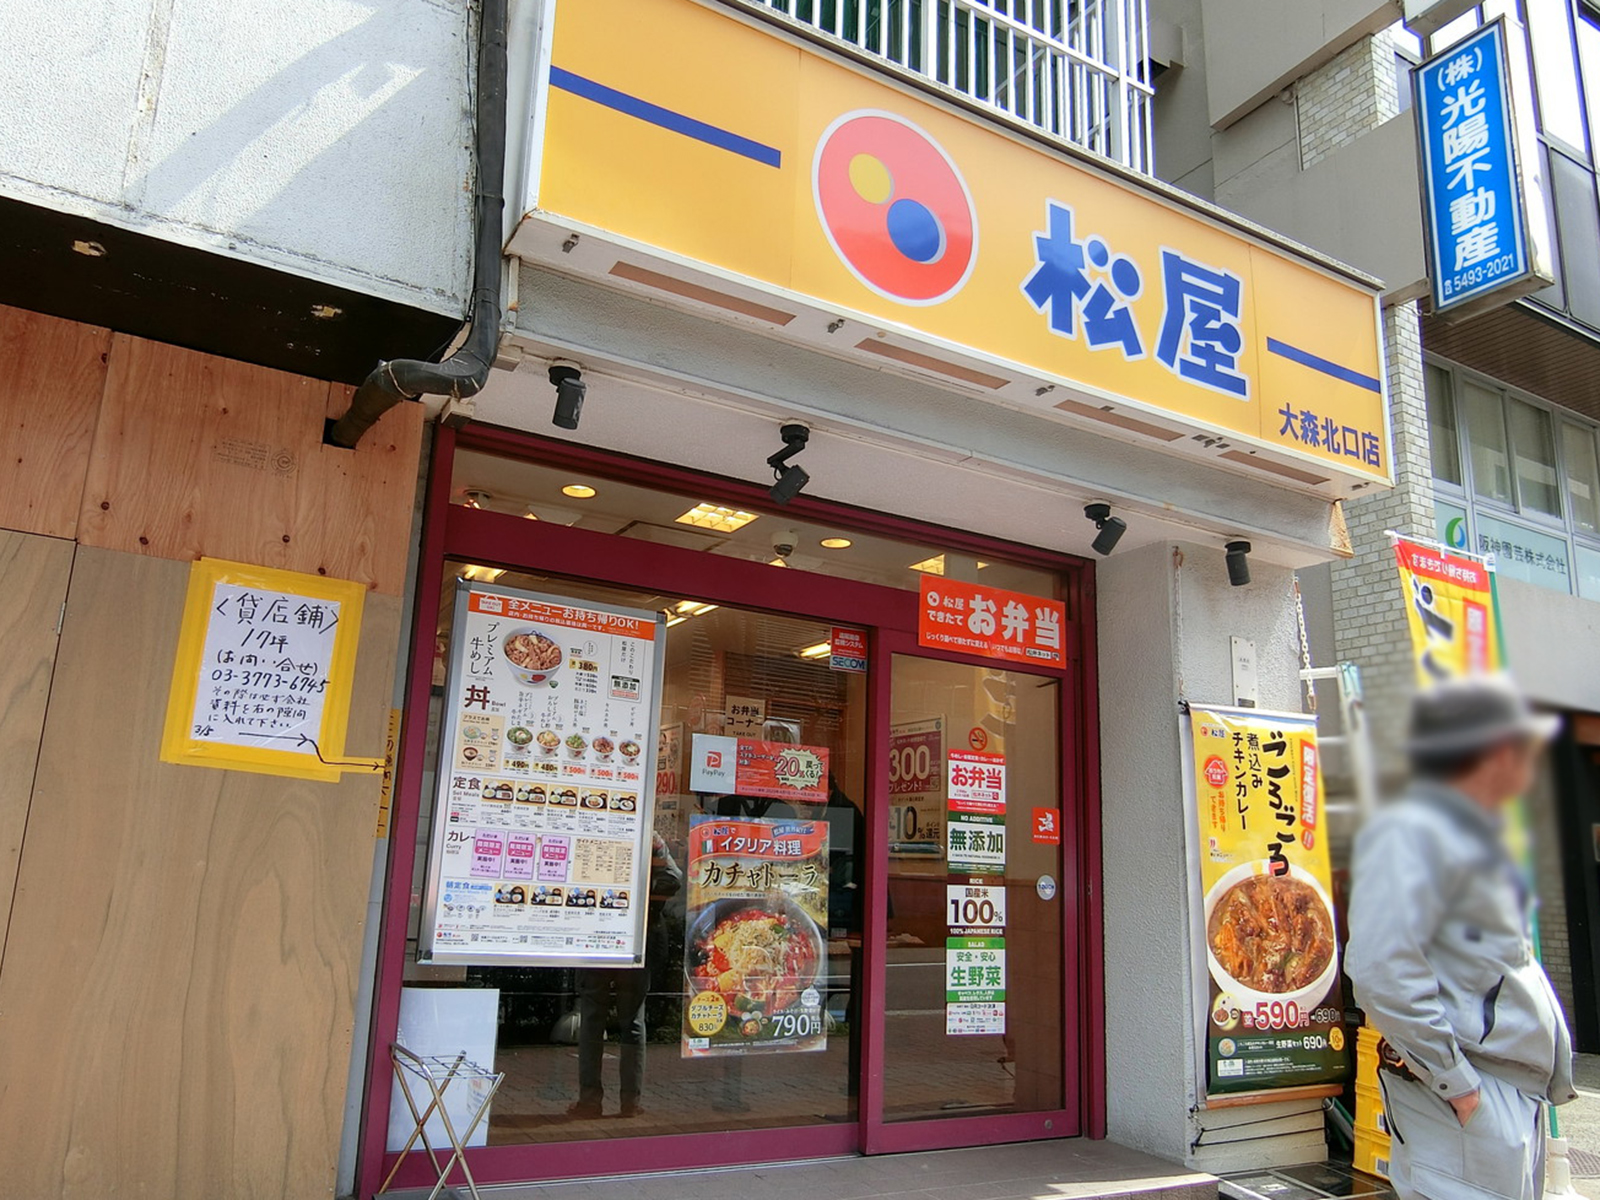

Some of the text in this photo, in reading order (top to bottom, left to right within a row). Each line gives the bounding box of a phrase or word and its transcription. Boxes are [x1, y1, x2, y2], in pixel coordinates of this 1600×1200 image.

[1453, 253, 1515, 292] 5493-2021
[1021, 199, 1249, 399] 松屋
[1278, 403, 1381, 468] 大森北口店
[508, 599, 640, 630] 全メニューお持ち帰りOK!
[943, 595, 964, 611] 松屋
[927, 609, 964, 626] できたて
[967, 593, 1060, 650] お弁当
[241, 628, 289, 653] 17坪
[483, 621, 500, 676] プレミアム
[470, 637, 482, 675] 牛めし
[832, 656, 865, 670] SECOM
[211, 669, 330, 693] 03-3773-6745
[464, 684, 491, 710] 丼
[726, 717, 763, 727] コーナー
[731, 704, 760, 717] お弁当
[1211, 728, 1226, 738] 松屋
[702, 768, 726, 778] PayPay
[805, 760, 823, 770] 戻って
[1246, 732, 1263, 789] 煮込み
[452, 776, 481, 790] 定食
[951, 764, 1002, 790] お弁当
[1232, 732, 1249, 830] チキンカレー
[1262, 730, 1296, 877] ごろごろ
[720, 836, 802, 856] イタリア料理
[950, 828, 1003, 853] 無添加
[701, 860, 818, 889] カチャトーラ
[965, 888, 989, 898] 国産米
[950, 899, 1003, 924] 100%
[956, 951, 996, 962] 安全・安心
[950, 965, 1001, 987] 生野菜
[691, 1004, 724, 1012] ダブルチーズ
